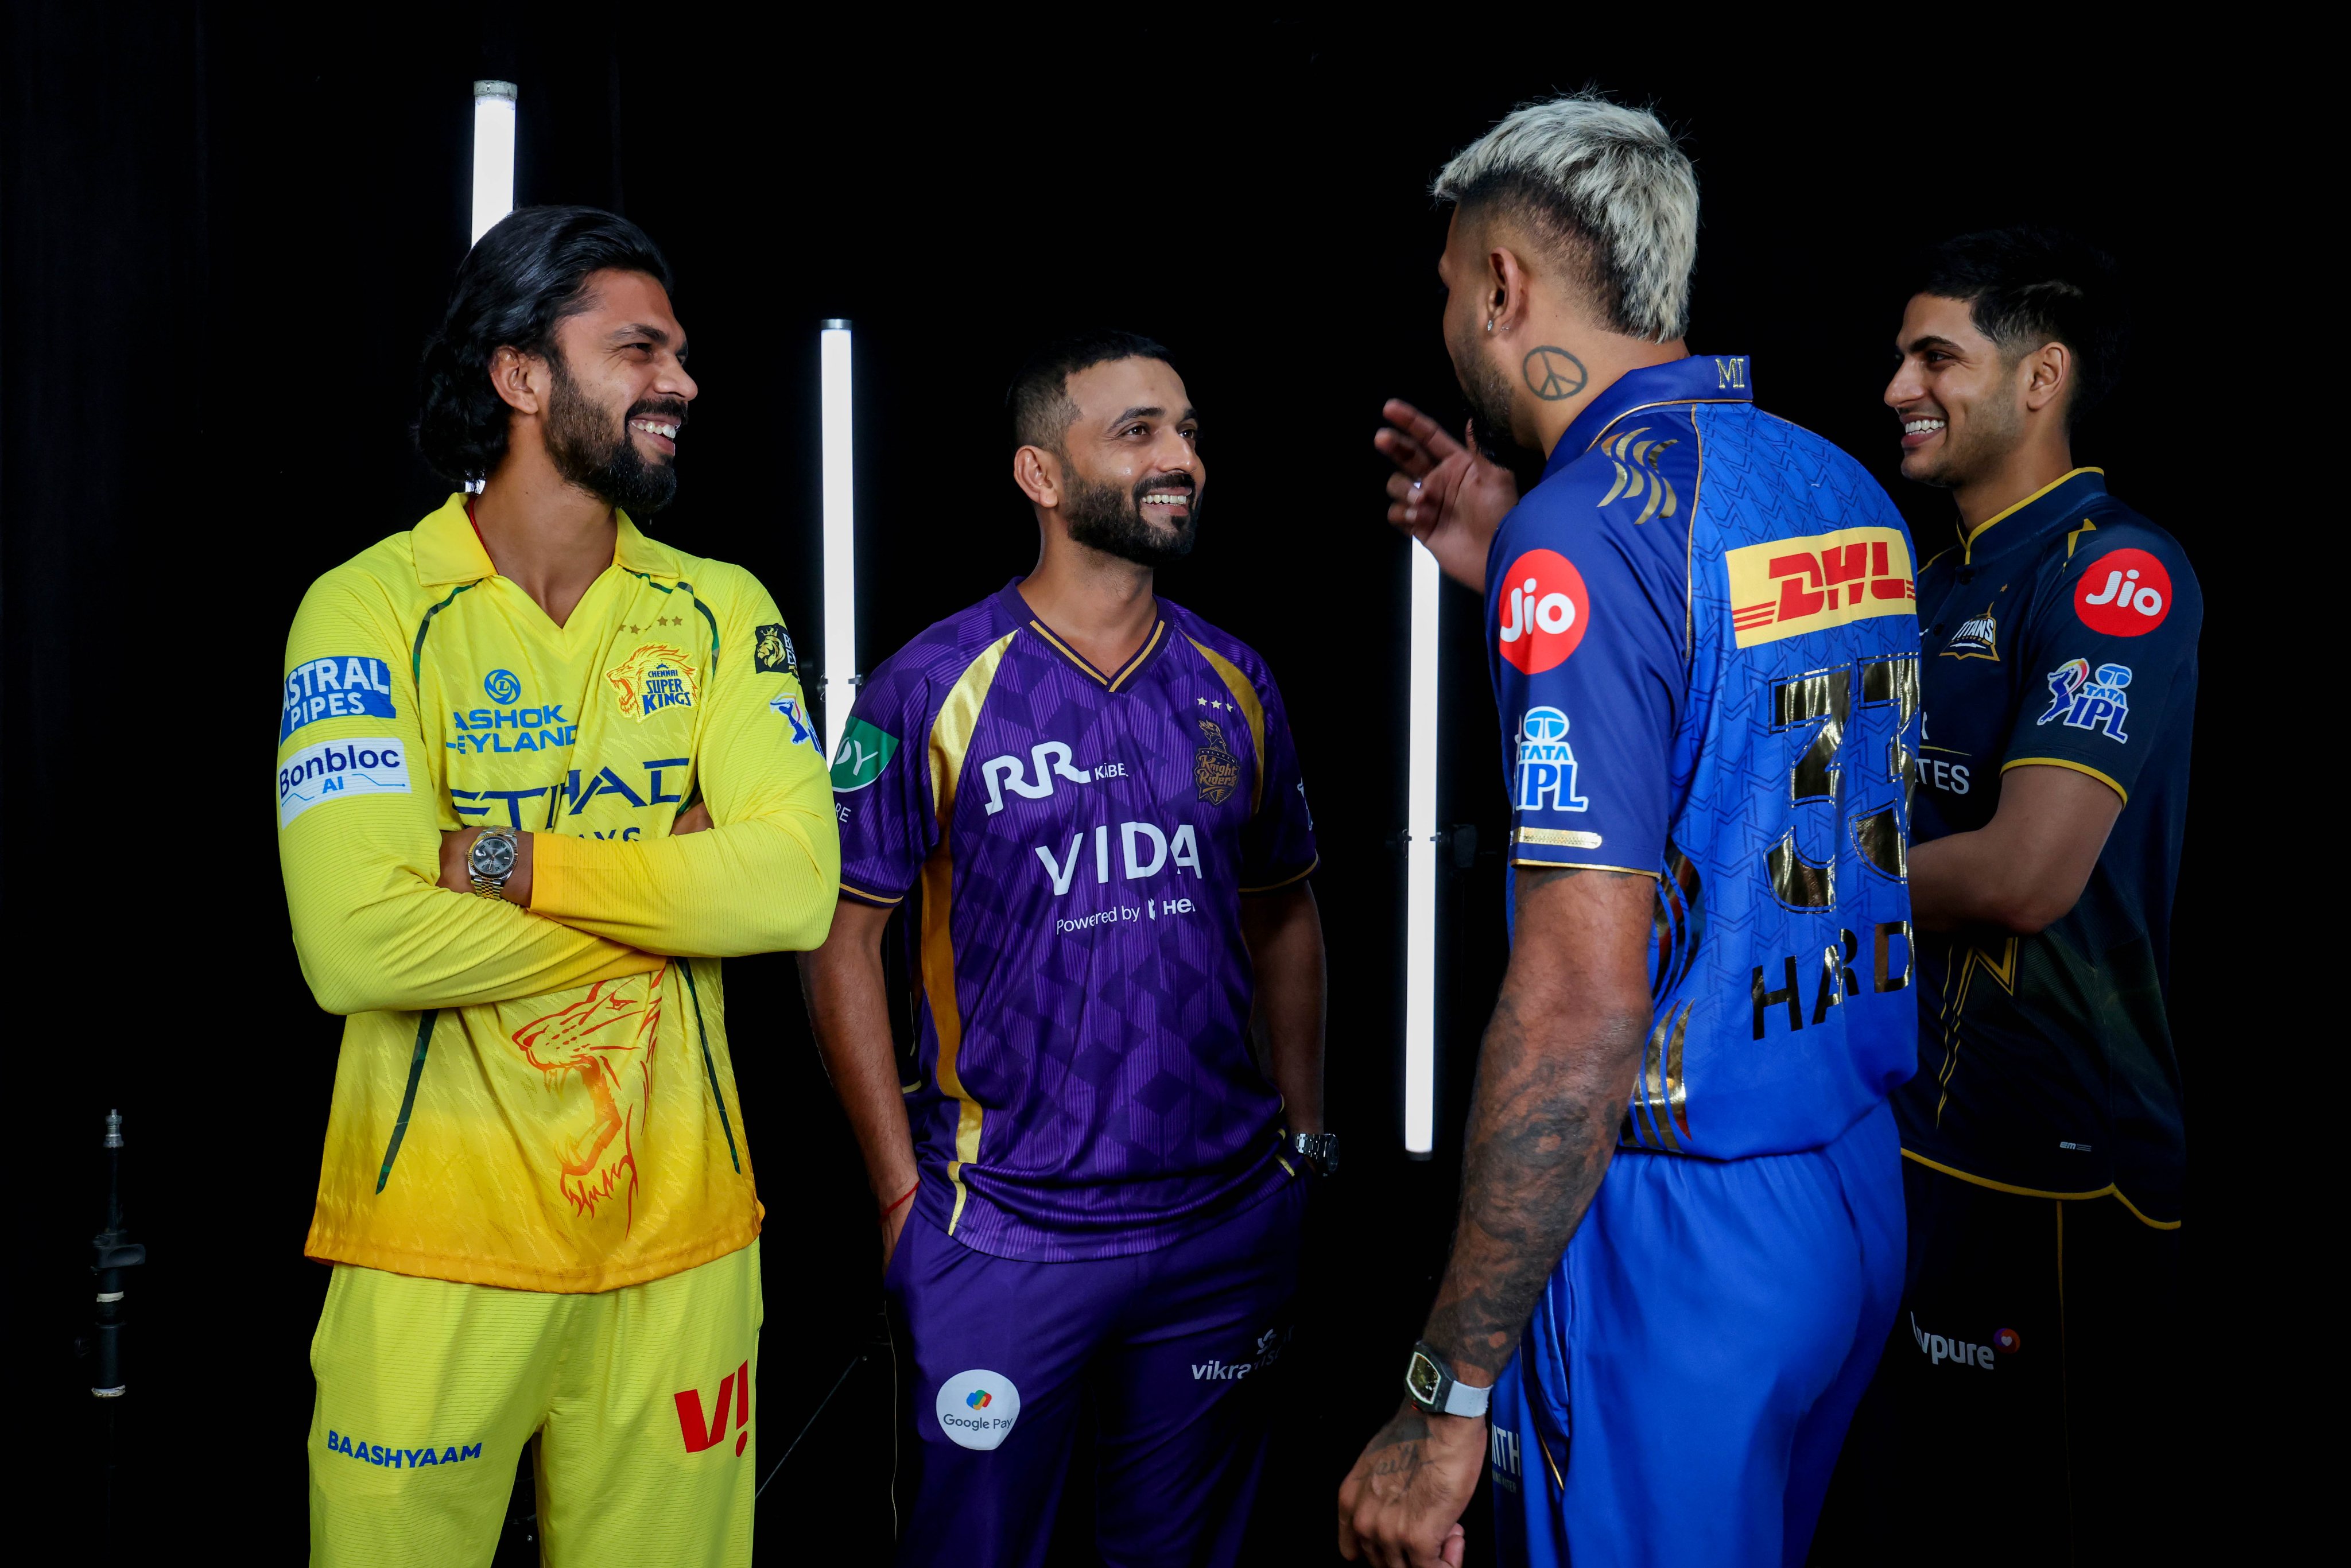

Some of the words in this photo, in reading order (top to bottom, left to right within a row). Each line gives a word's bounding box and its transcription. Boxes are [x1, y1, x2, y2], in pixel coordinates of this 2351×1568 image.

[1715, 358, 1745, 389] MI
[1769, 542, 1906, 622] DHL
[2085, 569, 2162, 616] Jio
[1500, 578, 1576, 642] Jio
[1952, 618, 1993, 643] TITANS
[646, 678, 684, 694] SUPER
[2086, 684, 2124, 705] TATA
[291, 692, 366, 732] PIPES
[642, 692, 691, 716] KINGS
[2066, 696, 2127, 740] IPL
[1198, 755, 1238, 776] Knight
[1521, 746, 1570, 760] TATA
[280, 745, 400, 799] Bonbloc
[323, 776, 344, 794] AI
[981, 741, 1092, 816] RR
[1197, 769, 1237, 787] Riders
[1516, 763, 1585, 809] IPL
[1034, 821, 1202, 895] VIDA
[1057, 907, 1117, 935] Powered
[1121, 905, 1140, 922] by
[1752, 921, 1915, 1041] HARD
[944, 1414, 990, 1431] Google
[994, 1418, 1013, 1429] Pay
[327, 1430, 482, 1469] BAASHYAAM
